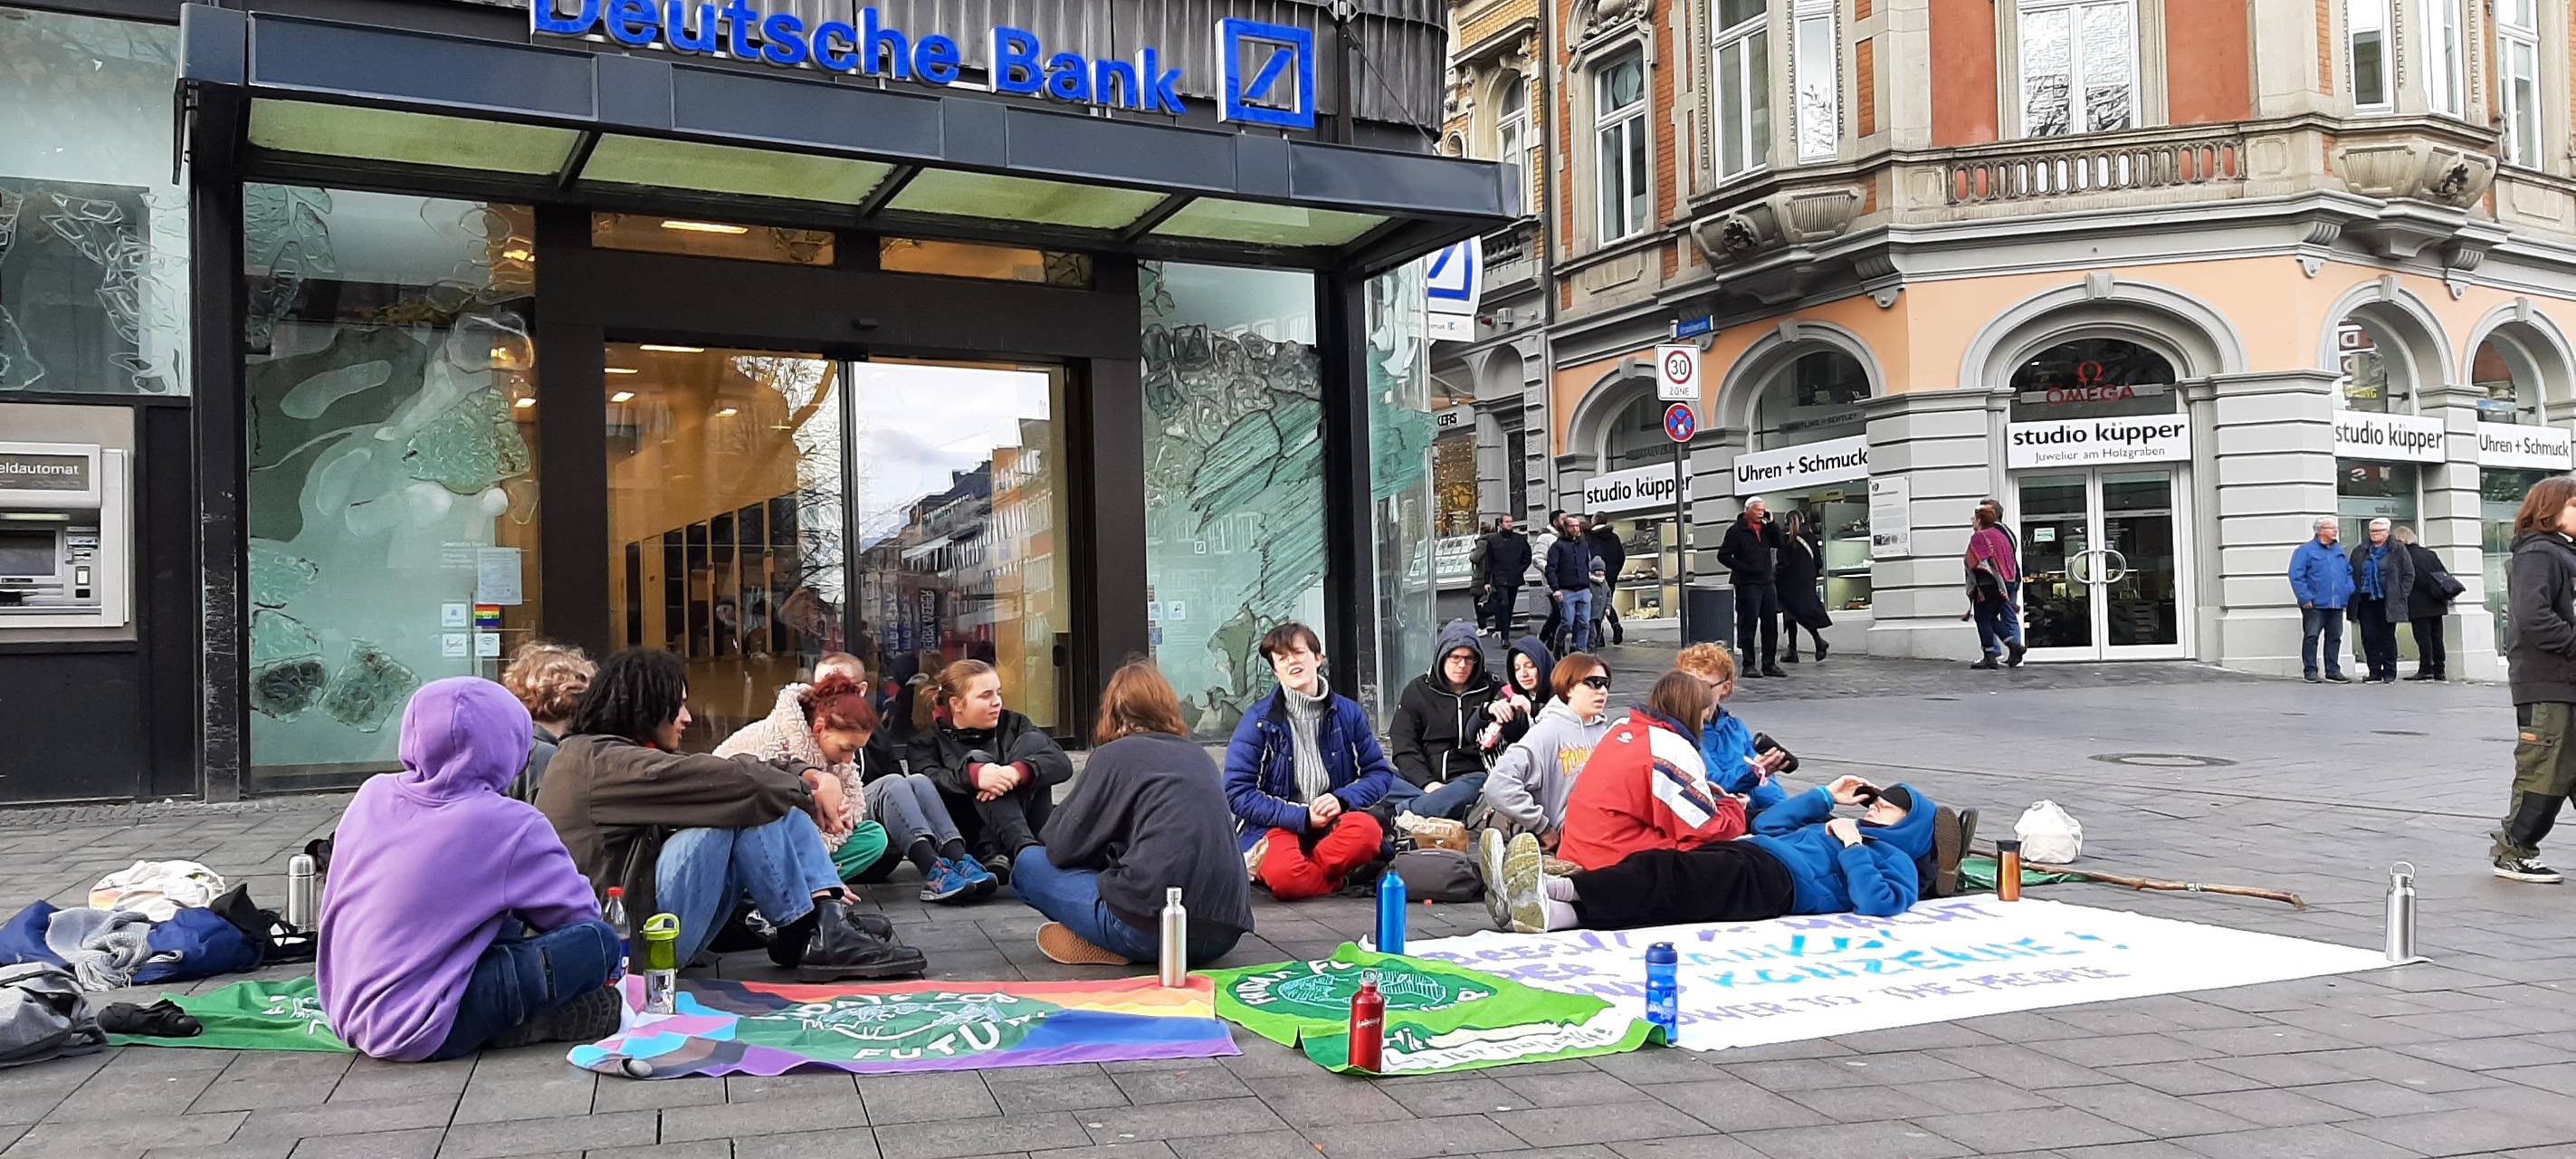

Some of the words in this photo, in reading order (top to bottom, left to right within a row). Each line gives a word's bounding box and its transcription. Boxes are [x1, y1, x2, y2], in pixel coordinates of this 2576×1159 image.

[532, 0, 959, 85] Deutsche
[989, 24, 1188, 116] Bank
[1671, 359, 1687, 375] 30
[1669, 387, 1690, 396] ZONE
[2046, 384, 2136, 406] OMEGA
[2013, 425, 2087, 446] studio
[2095, 422, 2185, 445] küpper
[2335, 421, 2383, 445] studio
[2389, 423, 2443, 454] küpper
[2035, 452, 2078, 464] Juwelier
[2103, 447, 2165, 460] Holzgraben
[2479, 434, 2512, 453] Uhren
[2515, 440, 2522, 451] +
[2524, 437, 2569, 457] Schmuck
[0, 462, 79, 475] eldautomat
[1738, 464, 1781, 483] Uhren
[1786, 461, 1795, 474] +
[1798, 447, 1869, 474] Schmuck
[1587, 481, 1631, 503] studio
[1676, 1001, 1805, 1026] OWER
